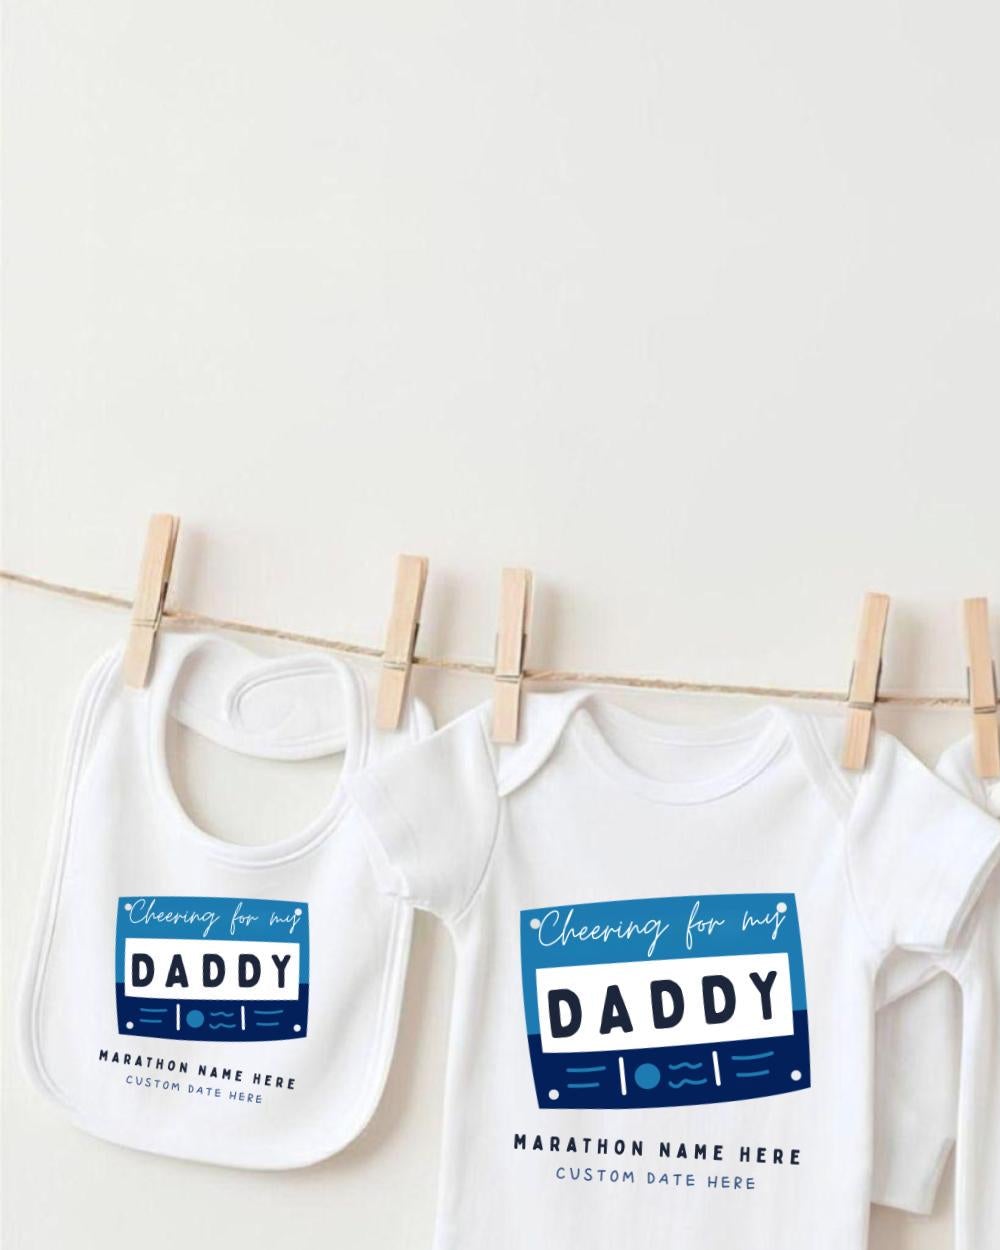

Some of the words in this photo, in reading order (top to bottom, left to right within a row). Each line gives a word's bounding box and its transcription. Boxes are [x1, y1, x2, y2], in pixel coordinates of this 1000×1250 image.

[128, 899, 219, 937] Cheering
[230, 902, 259, 936] for
[270, 909, 301, 934] my
[537, 910, 669, 957] Cheering
[686, 901, 725, 949] for
[742, 909, 787, 940] my
[132, 953, 291, 988] DADDY
[548, 971, 778, 1039] DADDY
[99, 1049, 188, 1073] MARATHON
[198, 1065, 242, 1081] NAME
[253, 1073, 295, 1090] HERE
[126, 1076, 179, 1091] CUSTOM
[188, 1085, 220, 1097] DATE
[229, 1091, 261, 1103] HERE
[514, 1134, 643, 1156] MARATHON
[660, 1142, 723, 1161] NAME
[740, 1146, 800, 1165] HERE
[556, 1167, 634, 1183] CUSTOM
[648, 1172, 695, 1186] DATE
[708, 1176, 755, 1189] HERE
